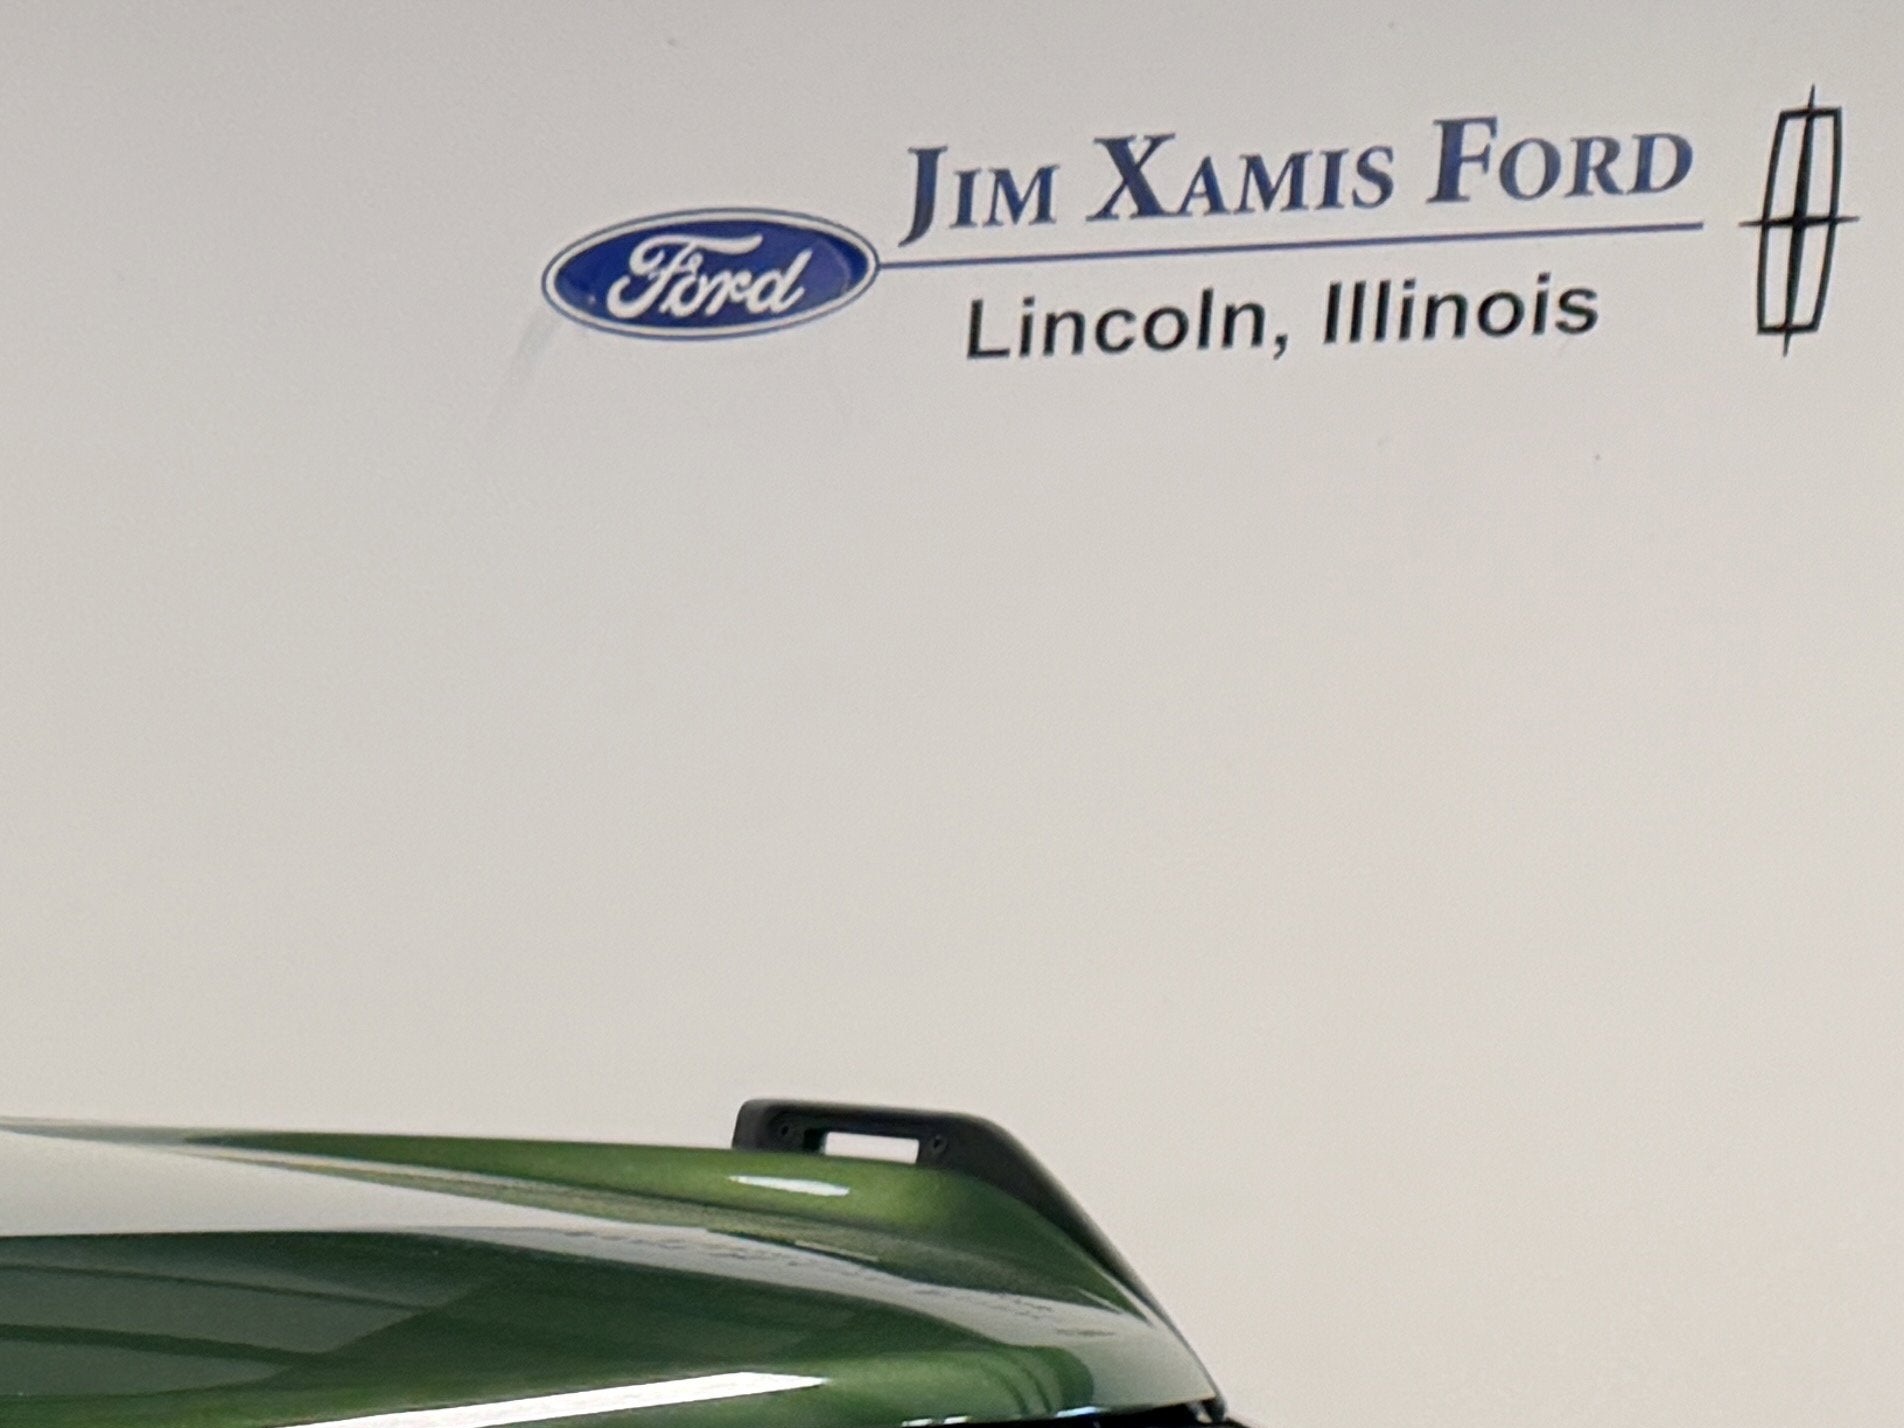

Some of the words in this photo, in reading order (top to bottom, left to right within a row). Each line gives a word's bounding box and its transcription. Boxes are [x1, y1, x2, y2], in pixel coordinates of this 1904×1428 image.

[896, 145, 1060, 248] JIM
[1084, 132, 1395, 224] XAMIS
[1425, 115, 1694, 204] FORD
[605, 233, 811, 320] Ford
[965, 287, 1289, 361] Lincoln,
[1323, 272, 1599, 345] Illinois
